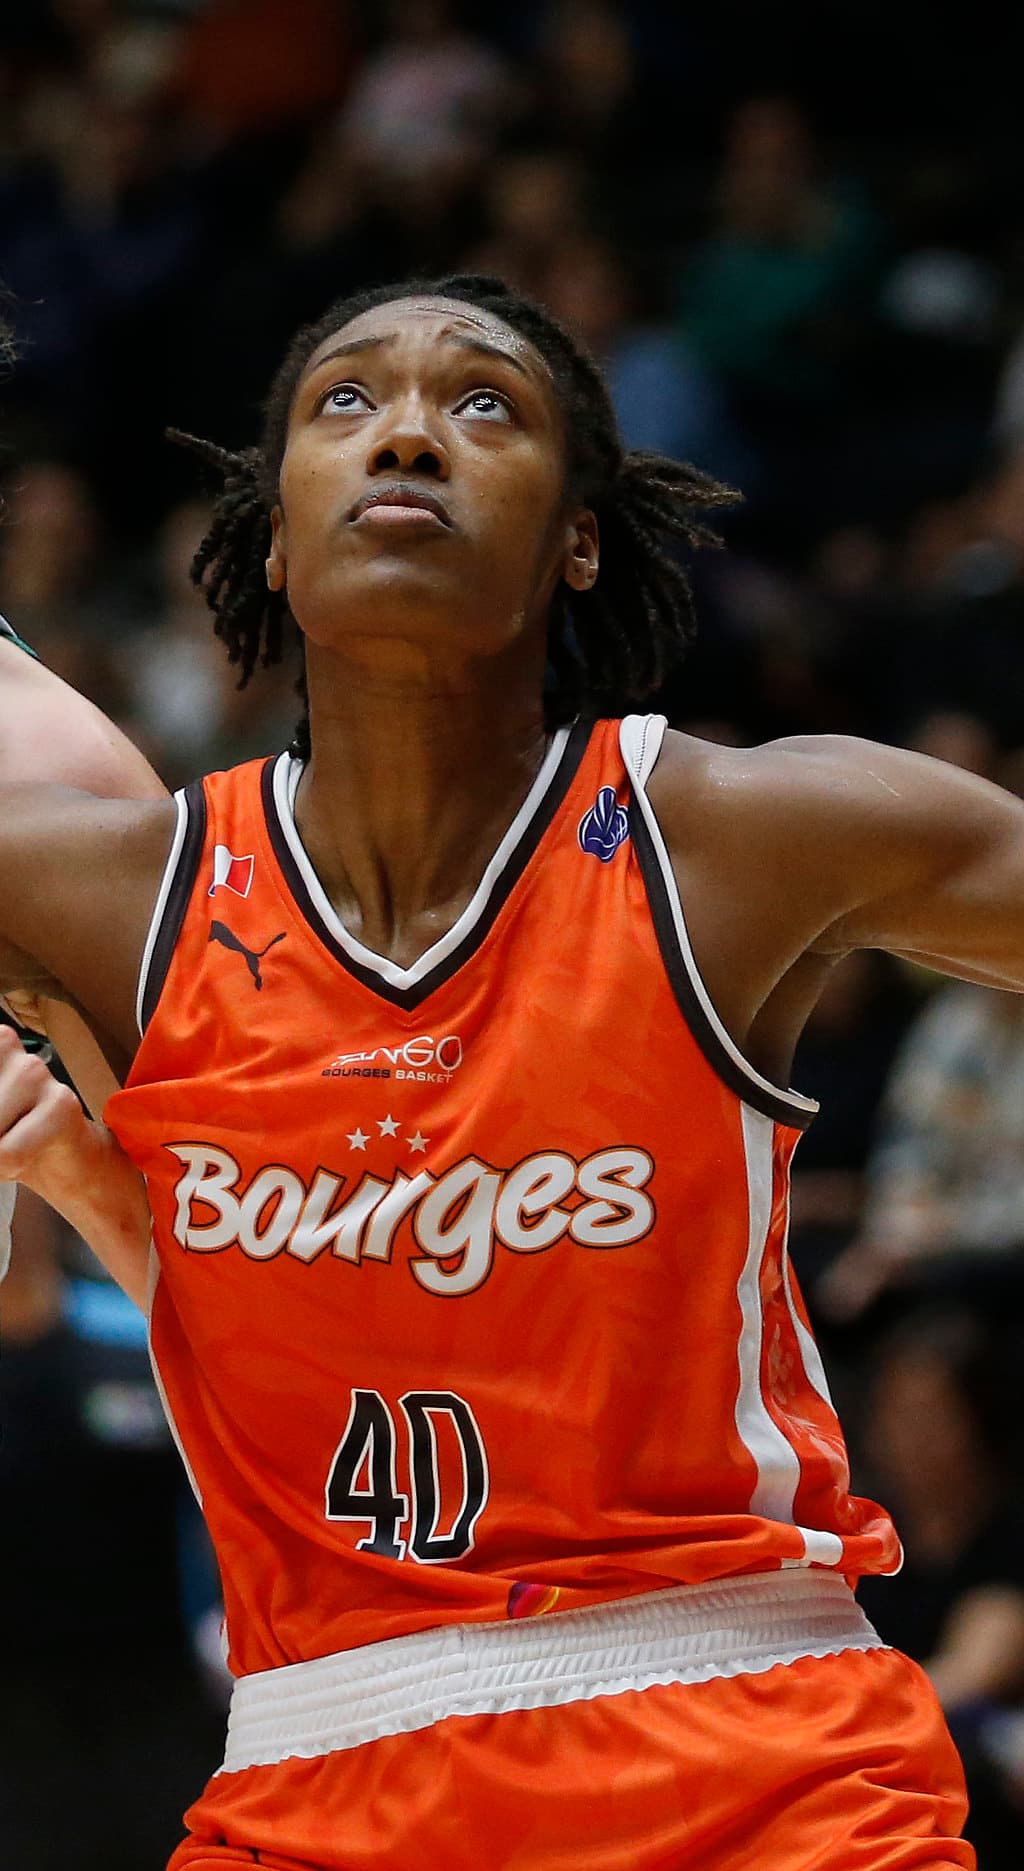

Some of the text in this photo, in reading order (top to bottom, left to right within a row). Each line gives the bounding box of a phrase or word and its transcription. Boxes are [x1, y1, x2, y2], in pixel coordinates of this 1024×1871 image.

[321, 1068, 453, 1084] BOURGES BASKET
[163, 1143, 656, 1297] Bourges
[325, 1388, 491, 1563] 40
